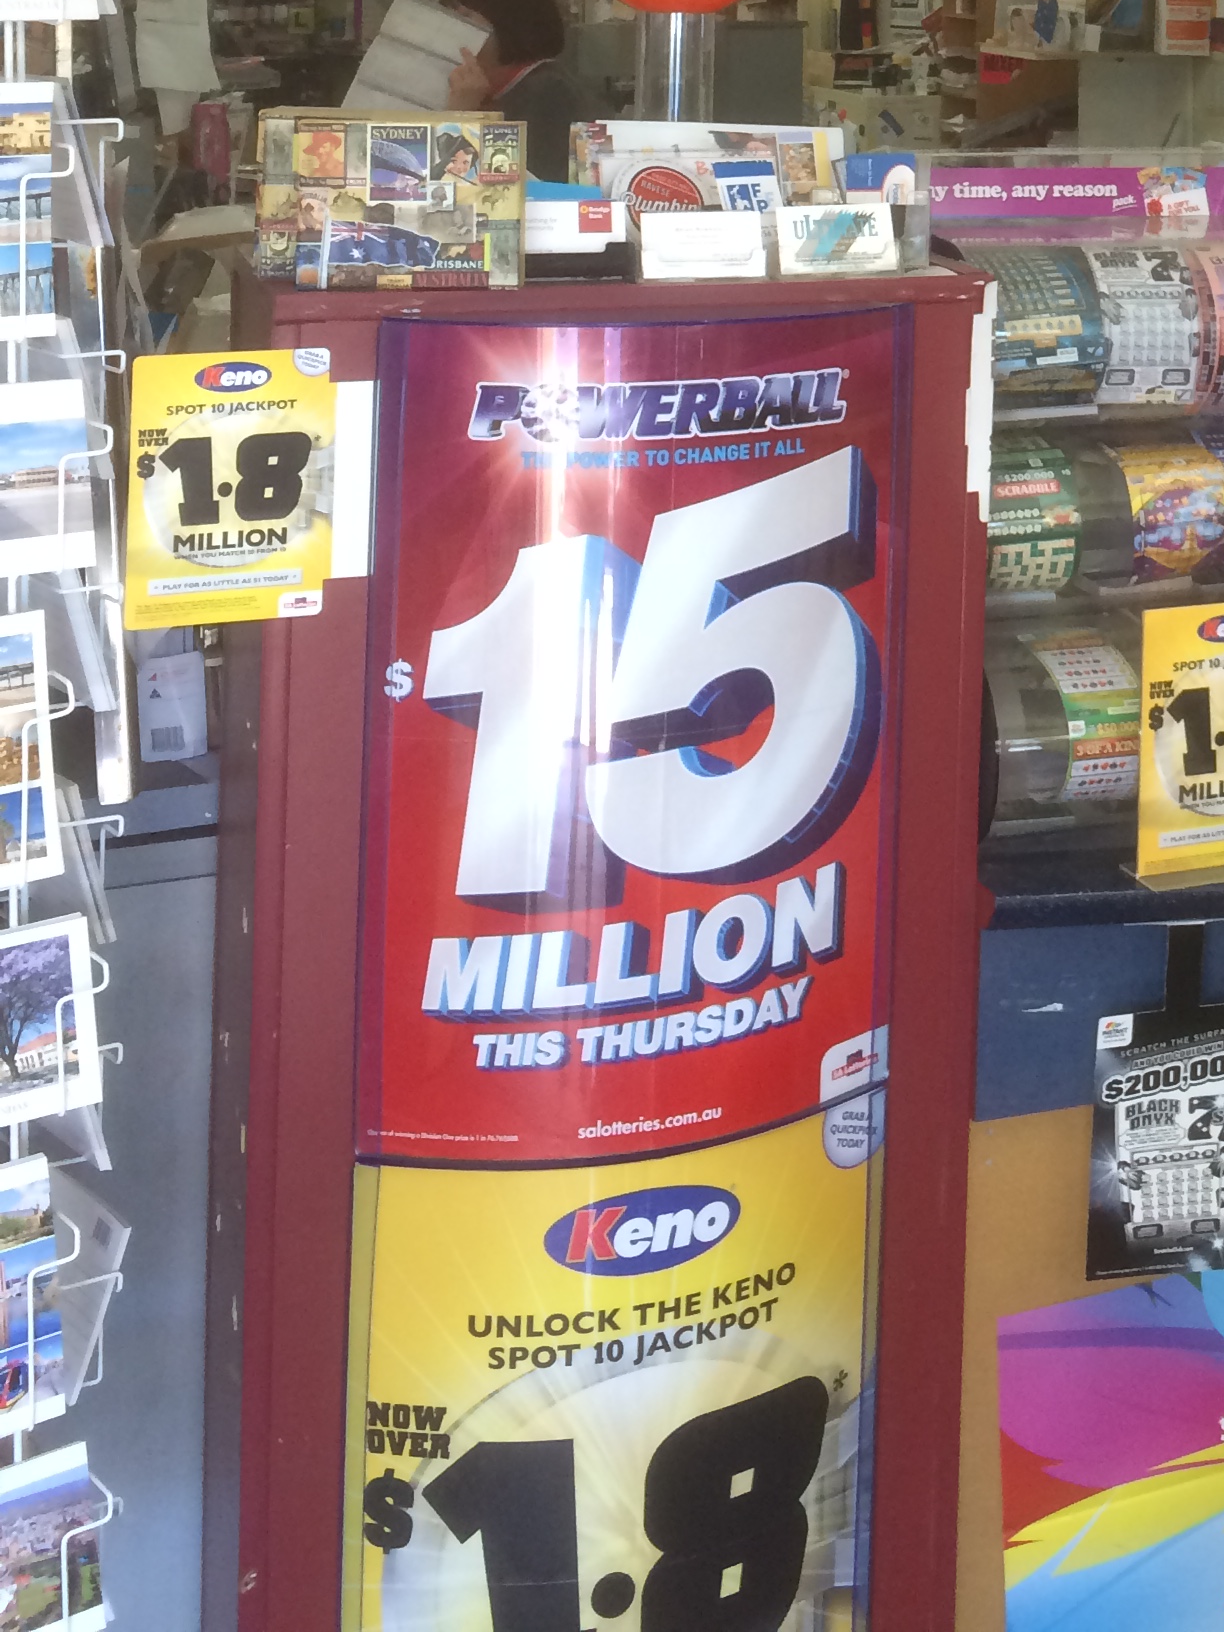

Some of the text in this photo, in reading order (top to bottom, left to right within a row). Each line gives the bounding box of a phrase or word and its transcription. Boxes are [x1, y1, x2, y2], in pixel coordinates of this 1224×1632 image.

[372, 128, 425, 140] SYDNEY
[953, 182, 1118, 202] time, any reason
[202, 365, 269, 389] Keno
[166, 399, 297, 416] SPOT 10 JACKPOT
[645, 448, 670, 466] TO
[675, 443, 750, 465] CHANGE
[754, 441, 770, 458] IT
[775, 438, 806, 457] ALL
[173, 527, 288, 553] MILLION
[422, 862, 846, 1024] MILLION
[473, 976, 813, 1069] THIS THURSDAY
[578, 1105, 722, 1140] salotteries.com.au
[565, 1201, 729, 1264] Keno
[468, 1262, 797, 1339] UNLOCK THE KENO
[487, 1297, 779, 1371] SPOT 10 JACKPOT
[366, 1400, 447, 1432] NOW
[366, 1430, 451, 1461] OVER
